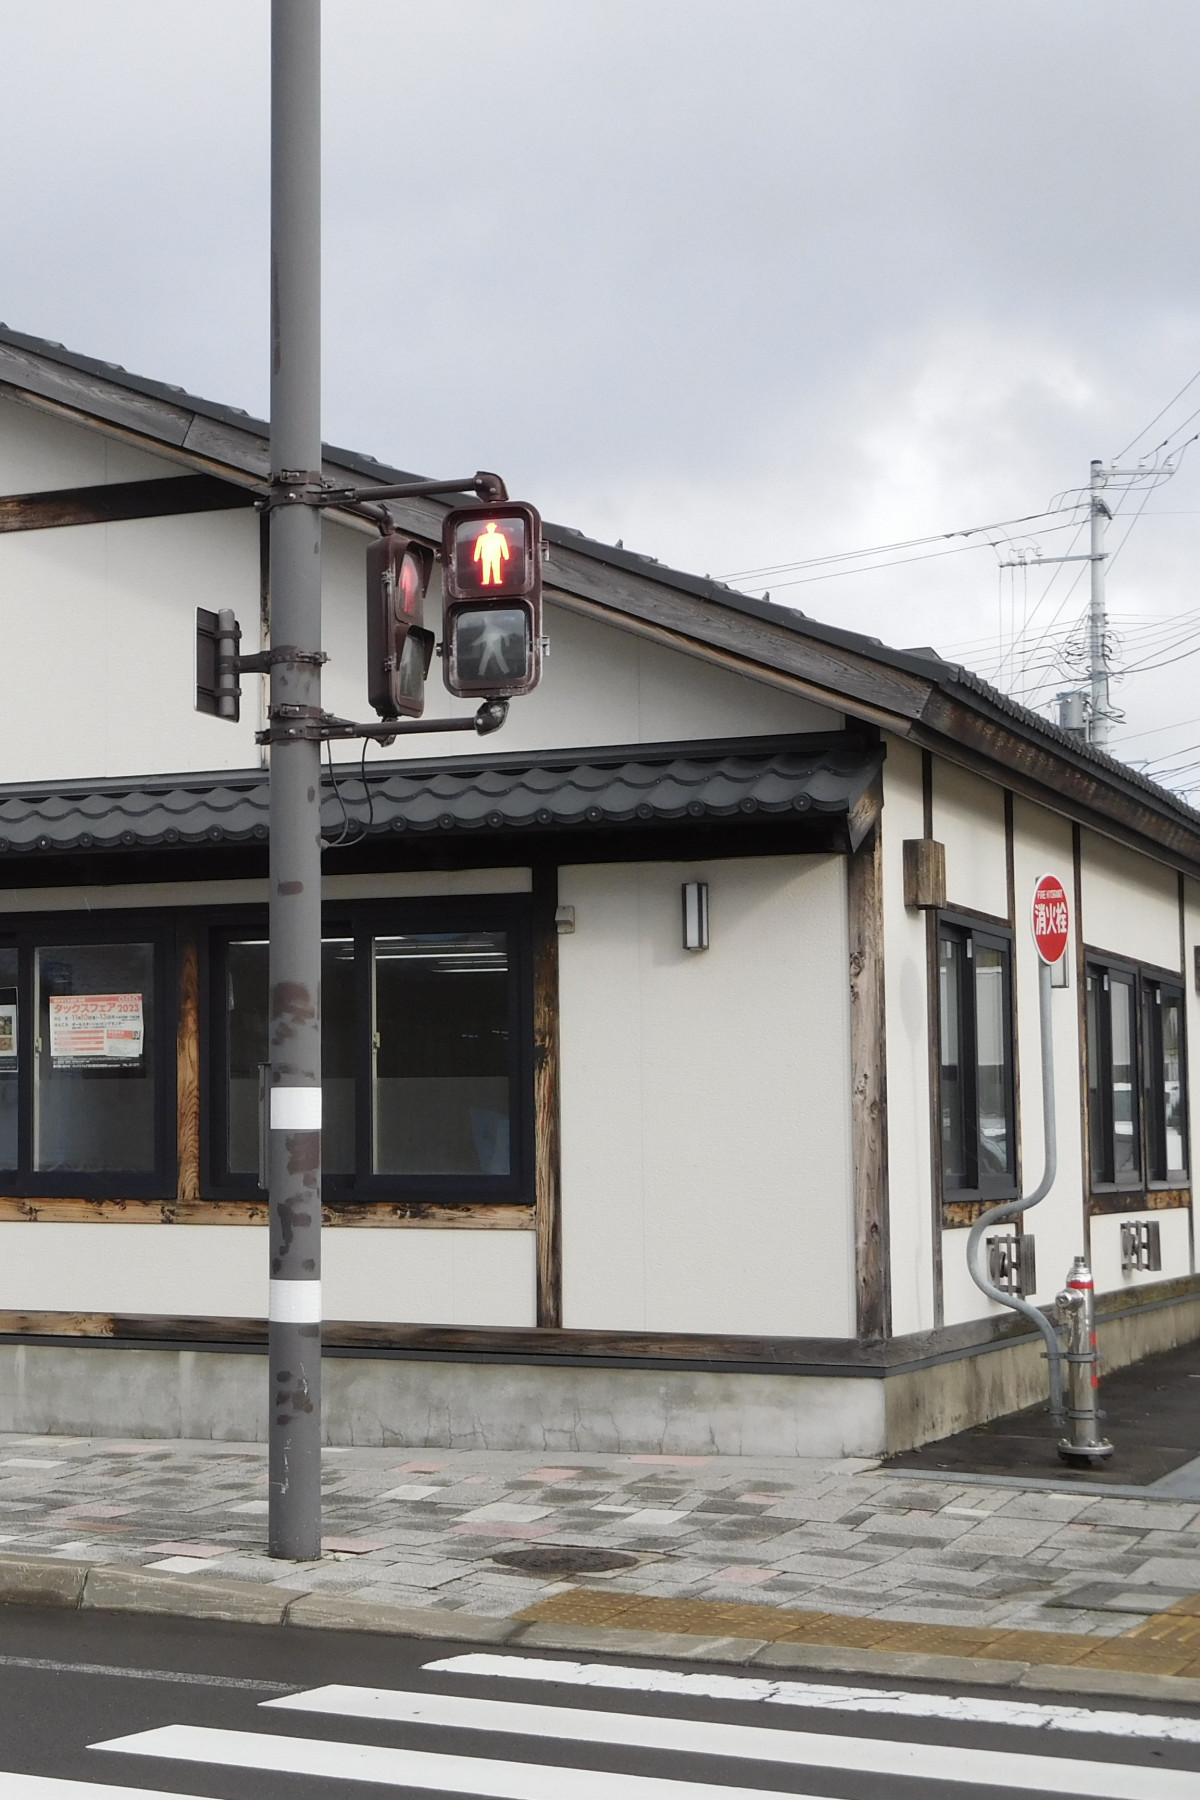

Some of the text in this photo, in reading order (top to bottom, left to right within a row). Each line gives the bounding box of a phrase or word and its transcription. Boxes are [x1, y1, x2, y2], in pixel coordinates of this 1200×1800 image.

[1035, 901, 1067, 936] 消火栓
[117, 1003, 141, 1013] 2023
